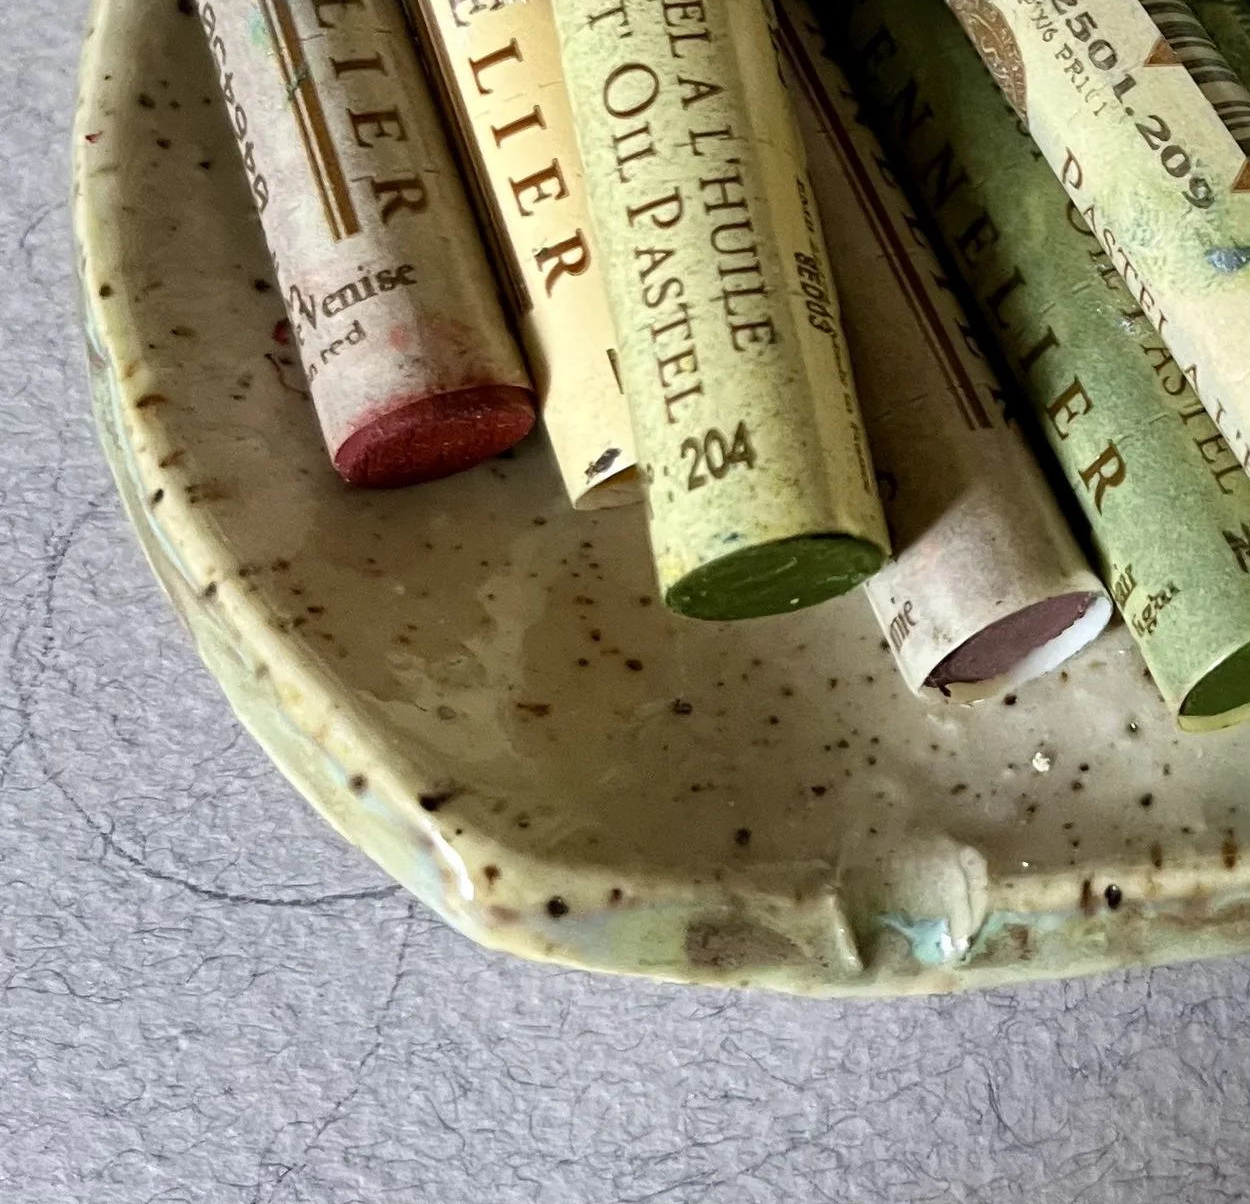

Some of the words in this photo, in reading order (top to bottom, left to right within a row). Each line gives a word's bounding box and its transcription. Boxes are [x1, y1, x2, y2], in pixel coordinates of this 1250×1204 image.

[603, 62, 661, 185] OIL
[677, 75, 726, 112] A
[689, 124, 777, 352] L'HUILE
[626, 185, 706, 426] PASTEL
[680, 419, 757, 492] 204
